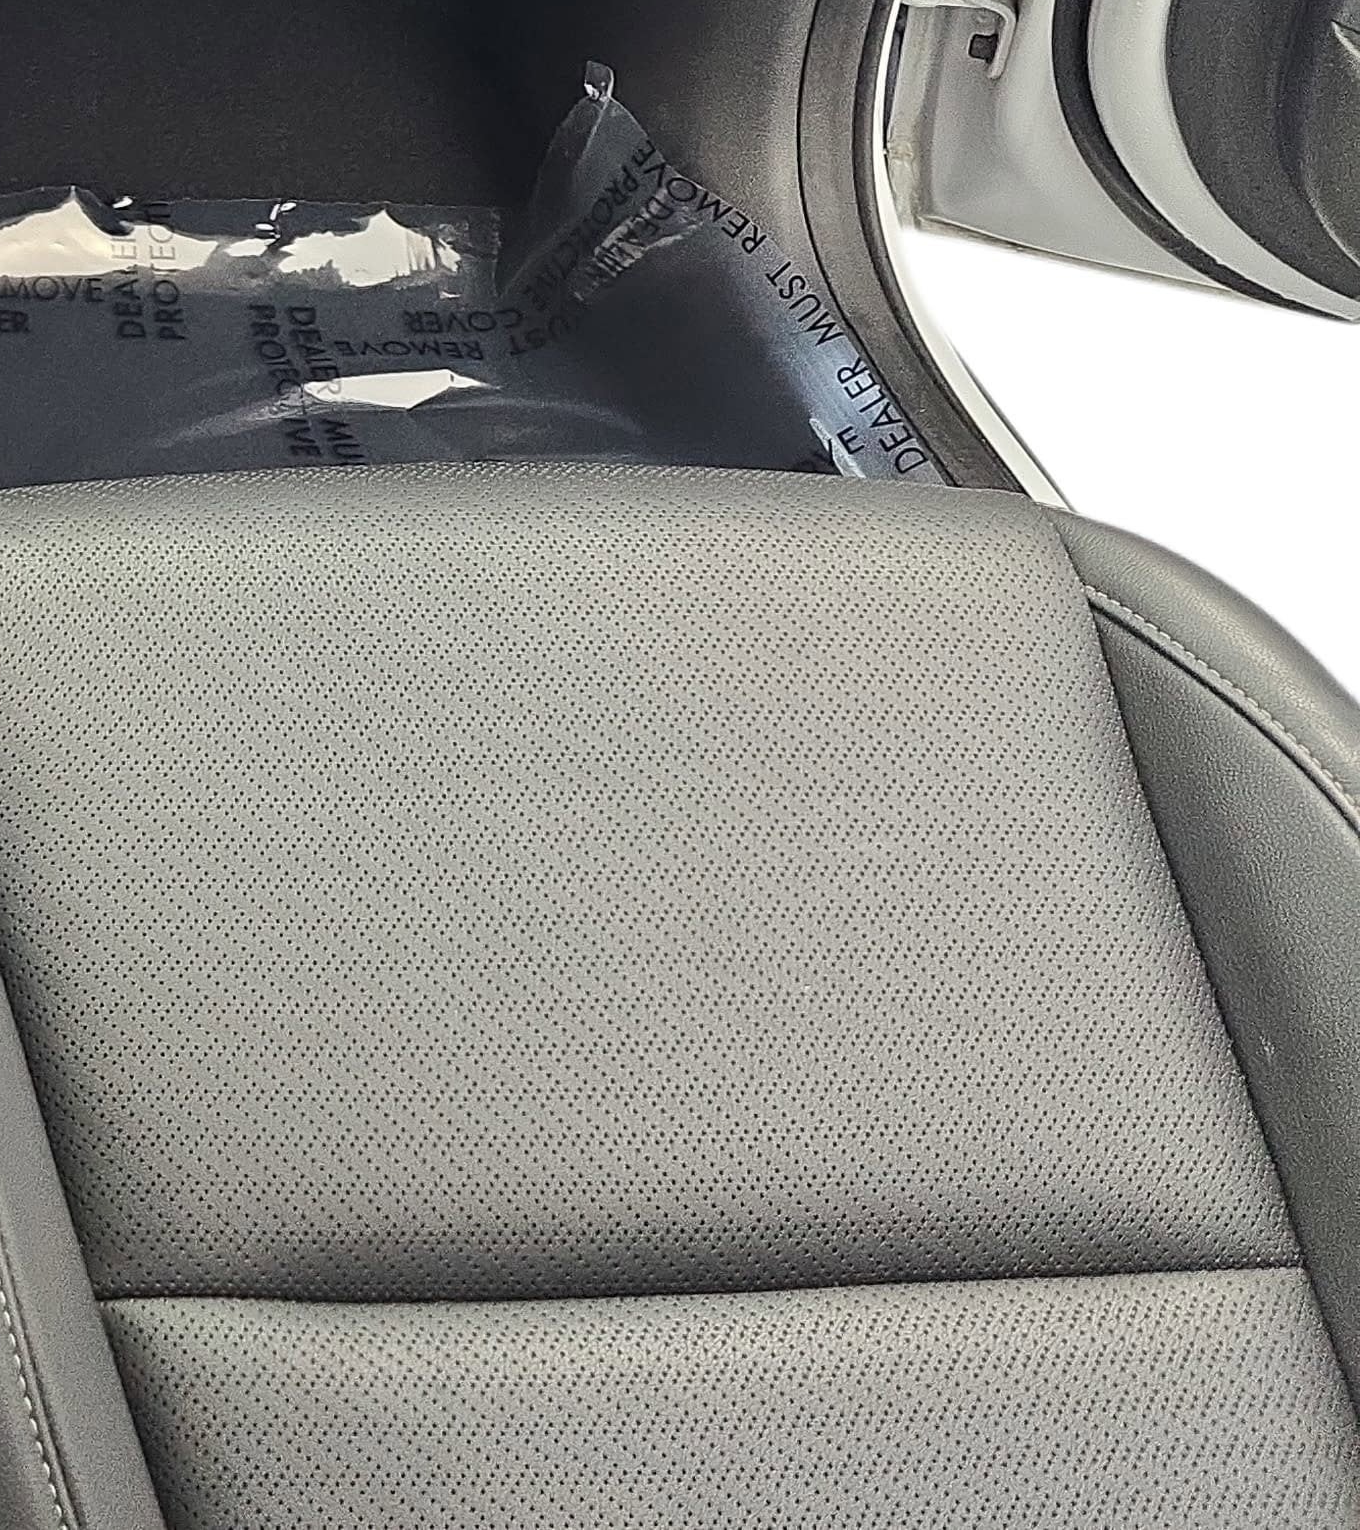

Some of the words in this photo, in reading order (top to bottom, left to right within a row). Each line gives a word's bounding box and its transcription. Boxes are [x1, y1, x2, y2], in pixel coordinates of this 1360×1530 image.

[633, 140, 767, 254] REMOVE
[403, 307, 524, 334] COVER
[766, 260, 845, 346] MUST
[333, 340, 484, 360] REMOVE
[836, 357, 928, 474] DEALER
